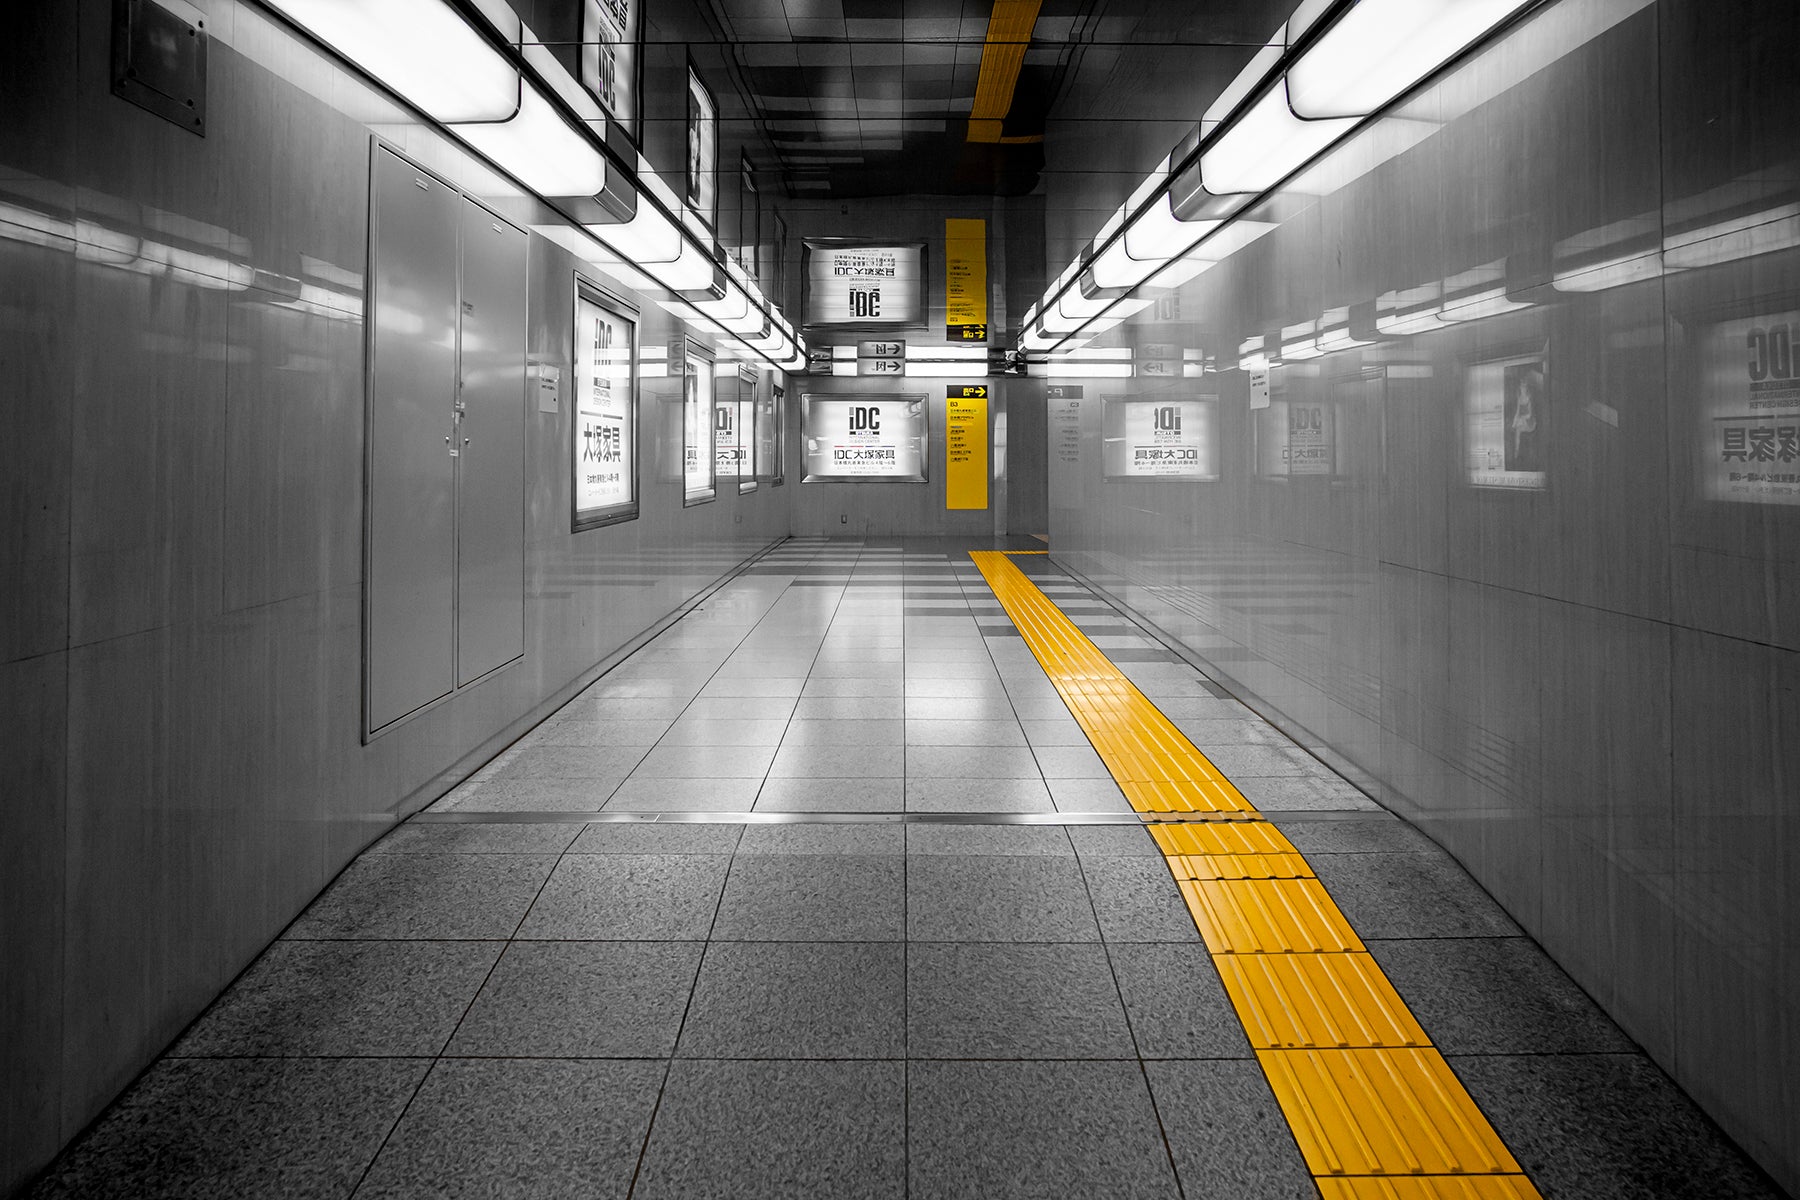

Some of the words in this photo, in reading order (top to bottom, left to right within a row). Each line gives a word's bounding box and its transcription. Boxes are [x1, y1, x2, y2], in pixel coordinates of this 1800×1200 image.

[849, 407, 880, 430] iDC
[583, 422, 621, 463] 大塚家具
[834, 450, 895, 460] IDC大塚家具
